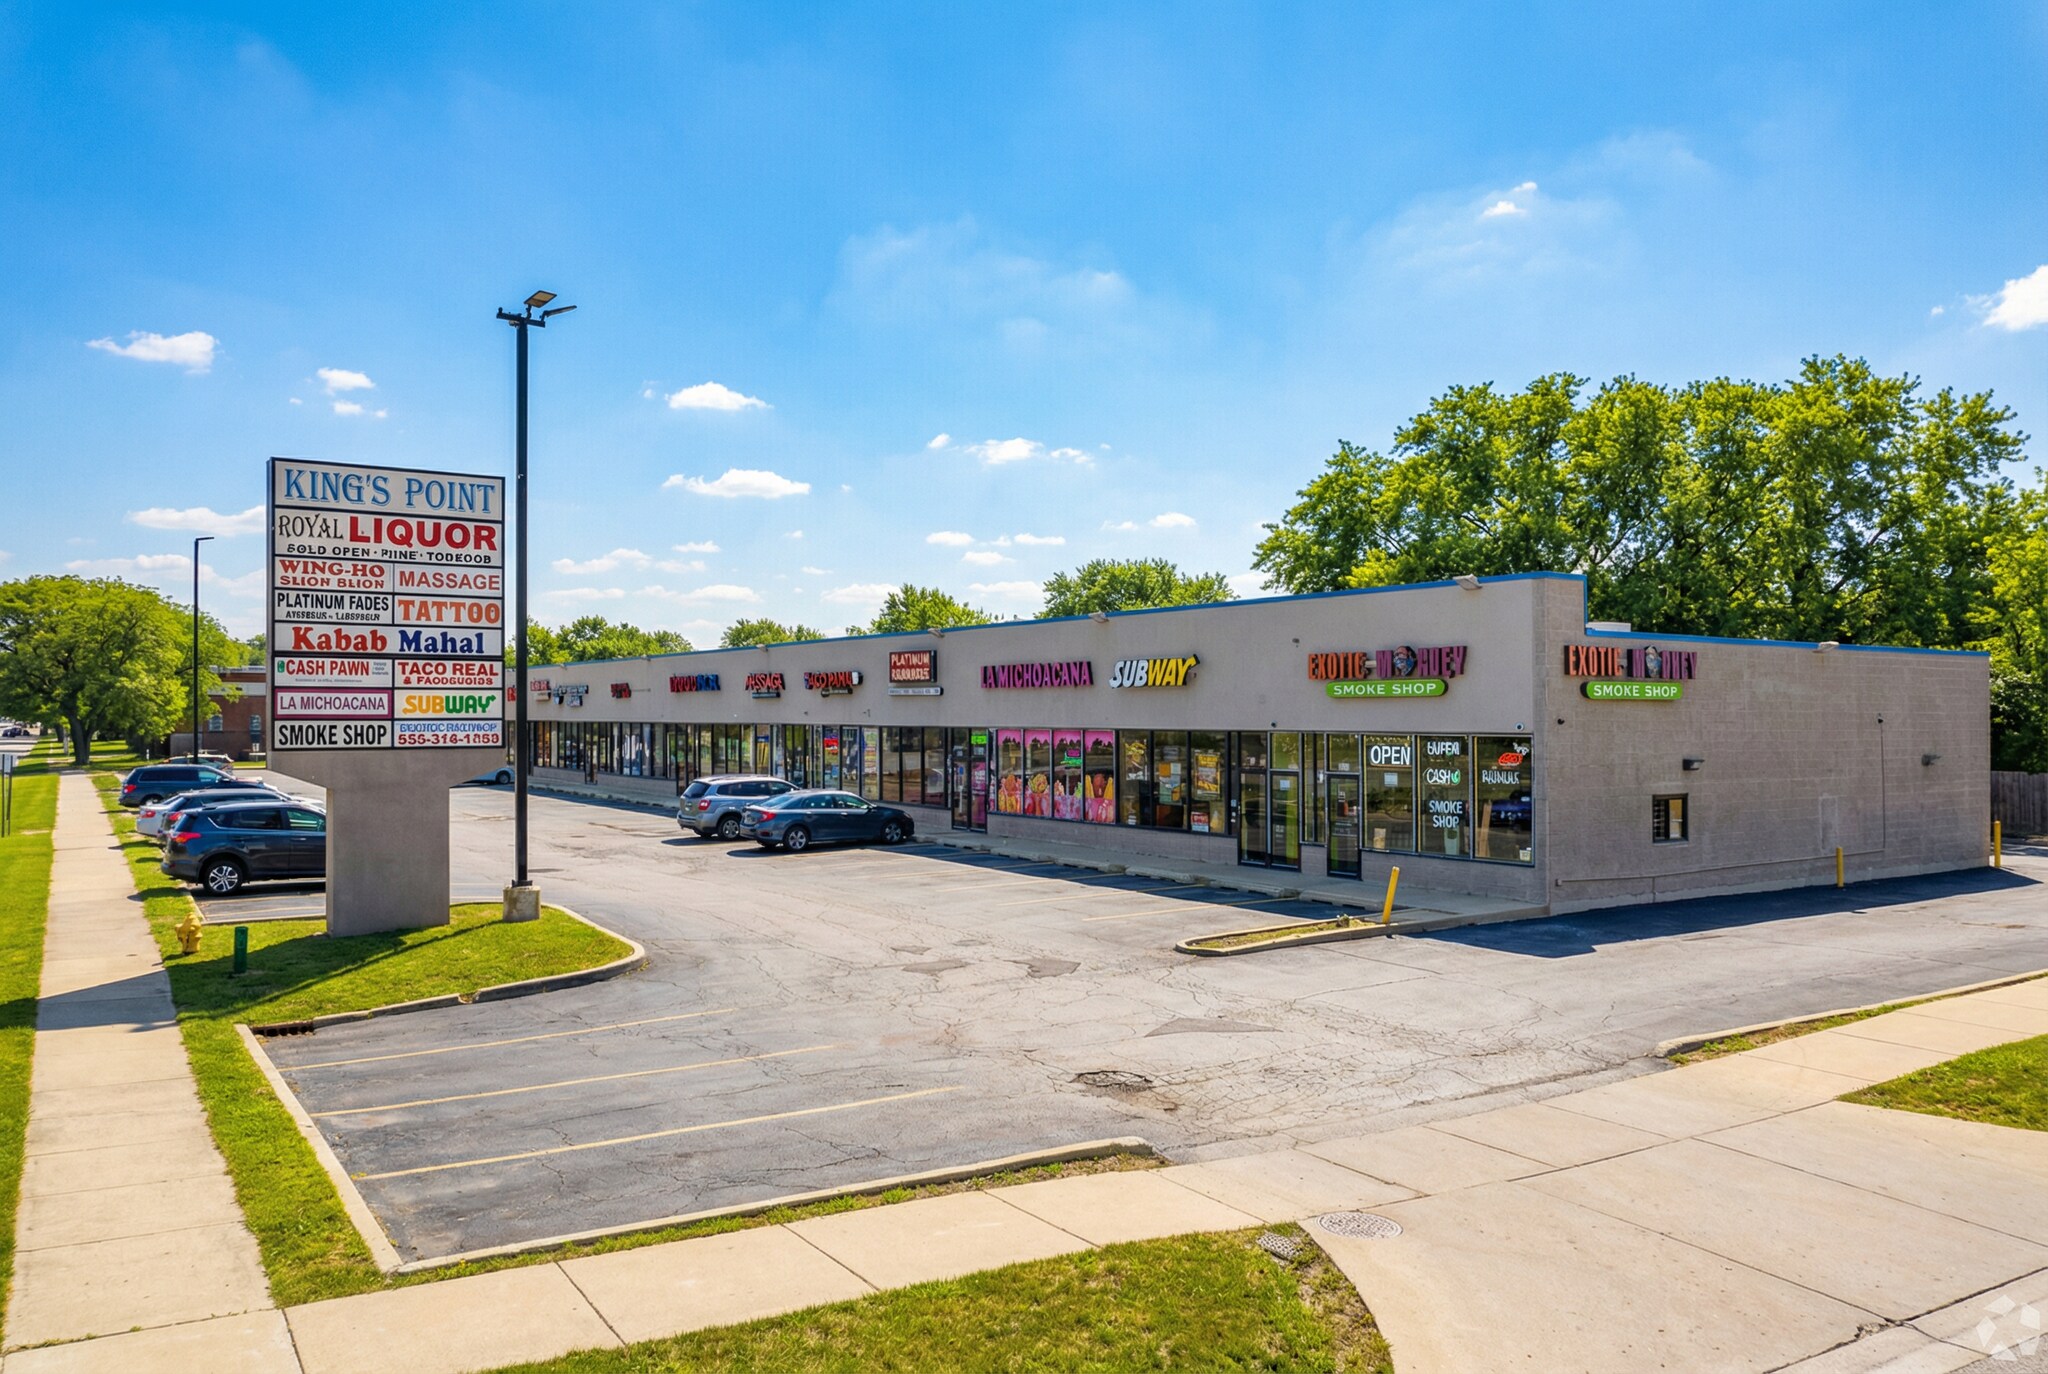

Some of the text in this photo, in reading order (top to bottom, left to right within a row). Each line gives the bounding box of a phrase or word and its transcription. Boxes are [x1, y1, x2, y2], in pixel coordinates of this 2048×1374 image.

[284, 468, 496, 514] KING'S POINT
[278, 513, 498, 551] ROYAL LIQUOR
[332, 546, 370, 557] OPEN
[279, 559, 385, 578] WING-HO
[399, 570, 500, 591] MASSAGE
[277, 592, 389, 611] PLATINUM FADES
[397, 599, 500, 625] TATTOO
[292, 626, 484, 654] Kabab Mahal
[286, 659, 325, 676] CASH
[329, 660, 370, 676] PAWN
[397, 661, 447, 676] TACO
[452, 662, 499, 677] REAL
[1568, 645, 1623, 677] EXOTIC
[1109, 654, 1200, 689] SUBWAY
[1333, 682, 1437, 695] SMOKE SHOP
[1593, 684, 1678, 697] SMOKE SHOP
[280, 695, 386, 712] LA MICHOACANA
[402, 694, 497, 715] SUBWAY
[278, 723, 338, 746] SMOKE
[343, 723, 387, 746] SHOP
[1370, 745, 1411, 765] OPEN
[1429, 800, 1463, 814] SMOKE
[1432, 815, 1460, 829] SHOP
